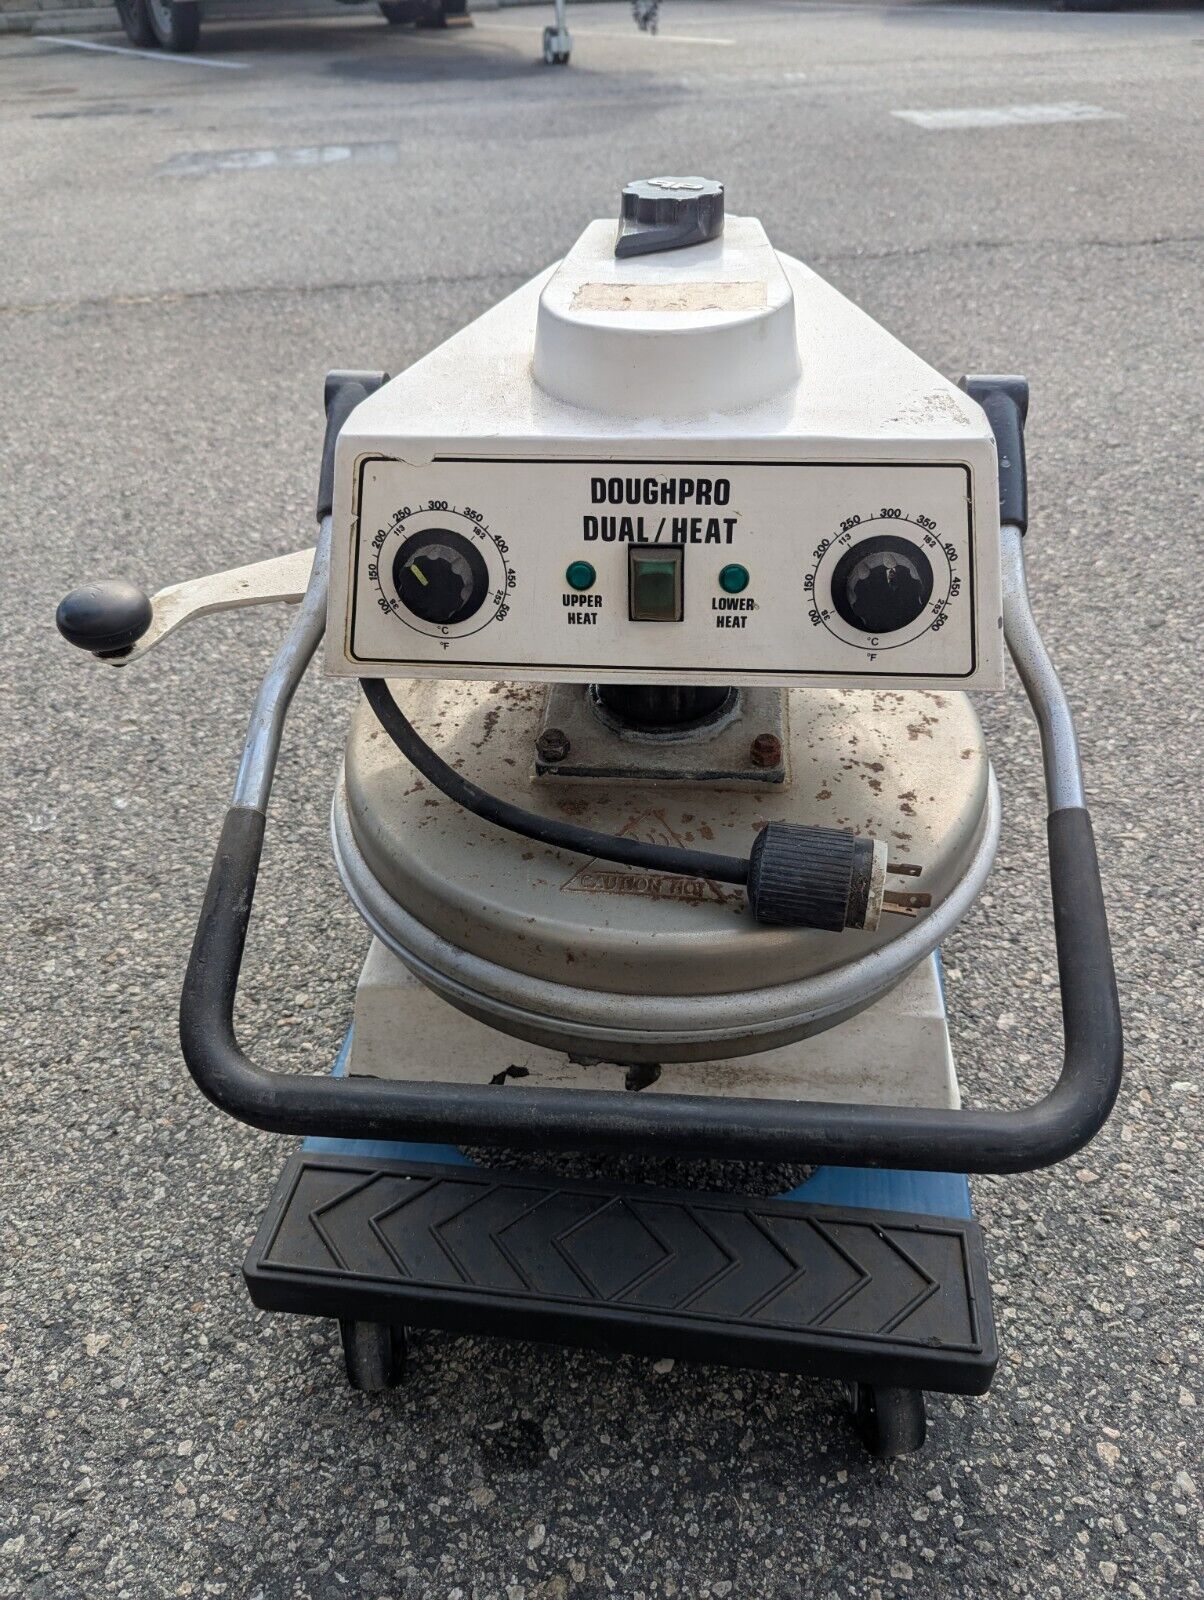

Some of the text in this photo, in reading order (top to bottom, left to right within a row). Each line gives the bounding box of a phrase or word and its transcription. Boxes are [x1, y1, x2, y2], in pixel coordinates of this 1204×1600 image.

[590, 477, 731, 506] DOUGHPRO
[428, 500, 448, 511] 300
[880, 508, 902, 518] 300
[392, 506, 412, 522] 250
[463, 506, 484, 522] 350
[916, 514, 937, 530] 350
[393, 524, 406, 537] 113
[840, 514, 861, 531] 250
[371, 529, 386, 549] 200
[472, 526, 487, 541] 182
[838, 533, 852, 546] 113
[923, 534, 937, 548] 182
[494, 534, 509, 553] 400
[813, 538, 830, 559] 200
[944, 542, 959, 562] 400
[368, 563, 378, 581] 150
[507, 568, 517, 588] 450
[803, 573, 814, 592] 150
[950, 576, 962, 597] 450
[377, 598, 392, 615] 100
[389, 598, 400, 610] 38
[562, 594, 603, 608] UPPER
[711, 597, 755, 611] LOWER
[495, 603, 510, 622] 500
[567, 612, 598, 625] HEAT
[808, 609, 821, 627] 100
[820, 609, 831, 621] 38
[716, 615, 747, 629] HEAT
[931, 612, 949, 632] 500
[580, 873, 664, 894] CAUTION
